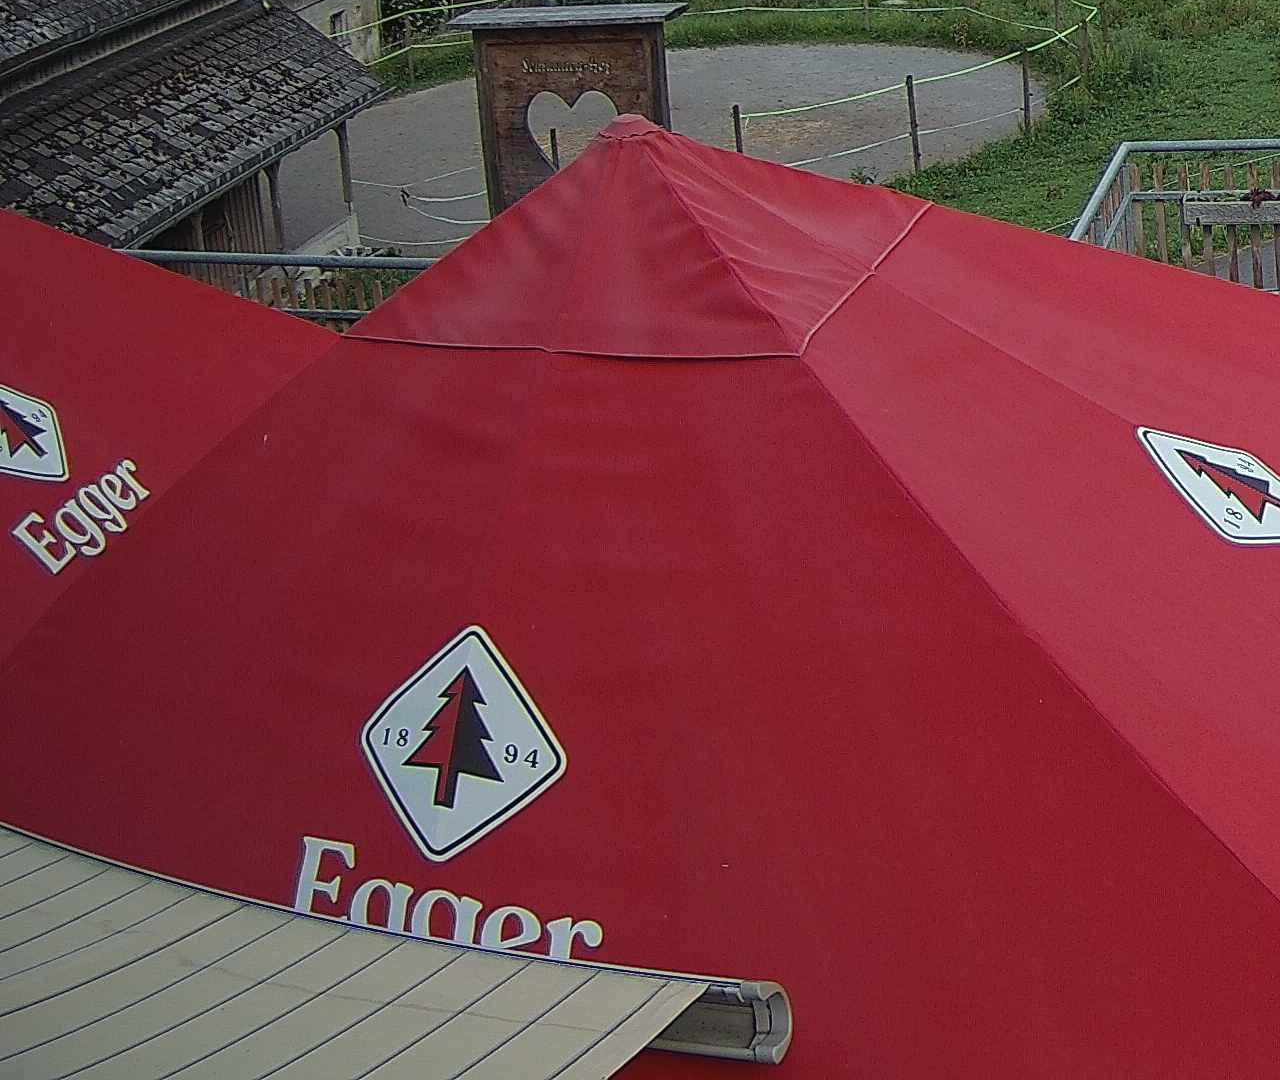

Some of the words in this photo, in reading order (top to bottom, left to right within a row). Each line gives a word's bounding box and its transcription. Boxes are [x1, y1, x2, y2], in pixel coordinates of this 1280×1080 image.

[11, 459, 151, 576] Egger
[382, 727, 410, 748] 18
[503, 743, 540, 769] 94
